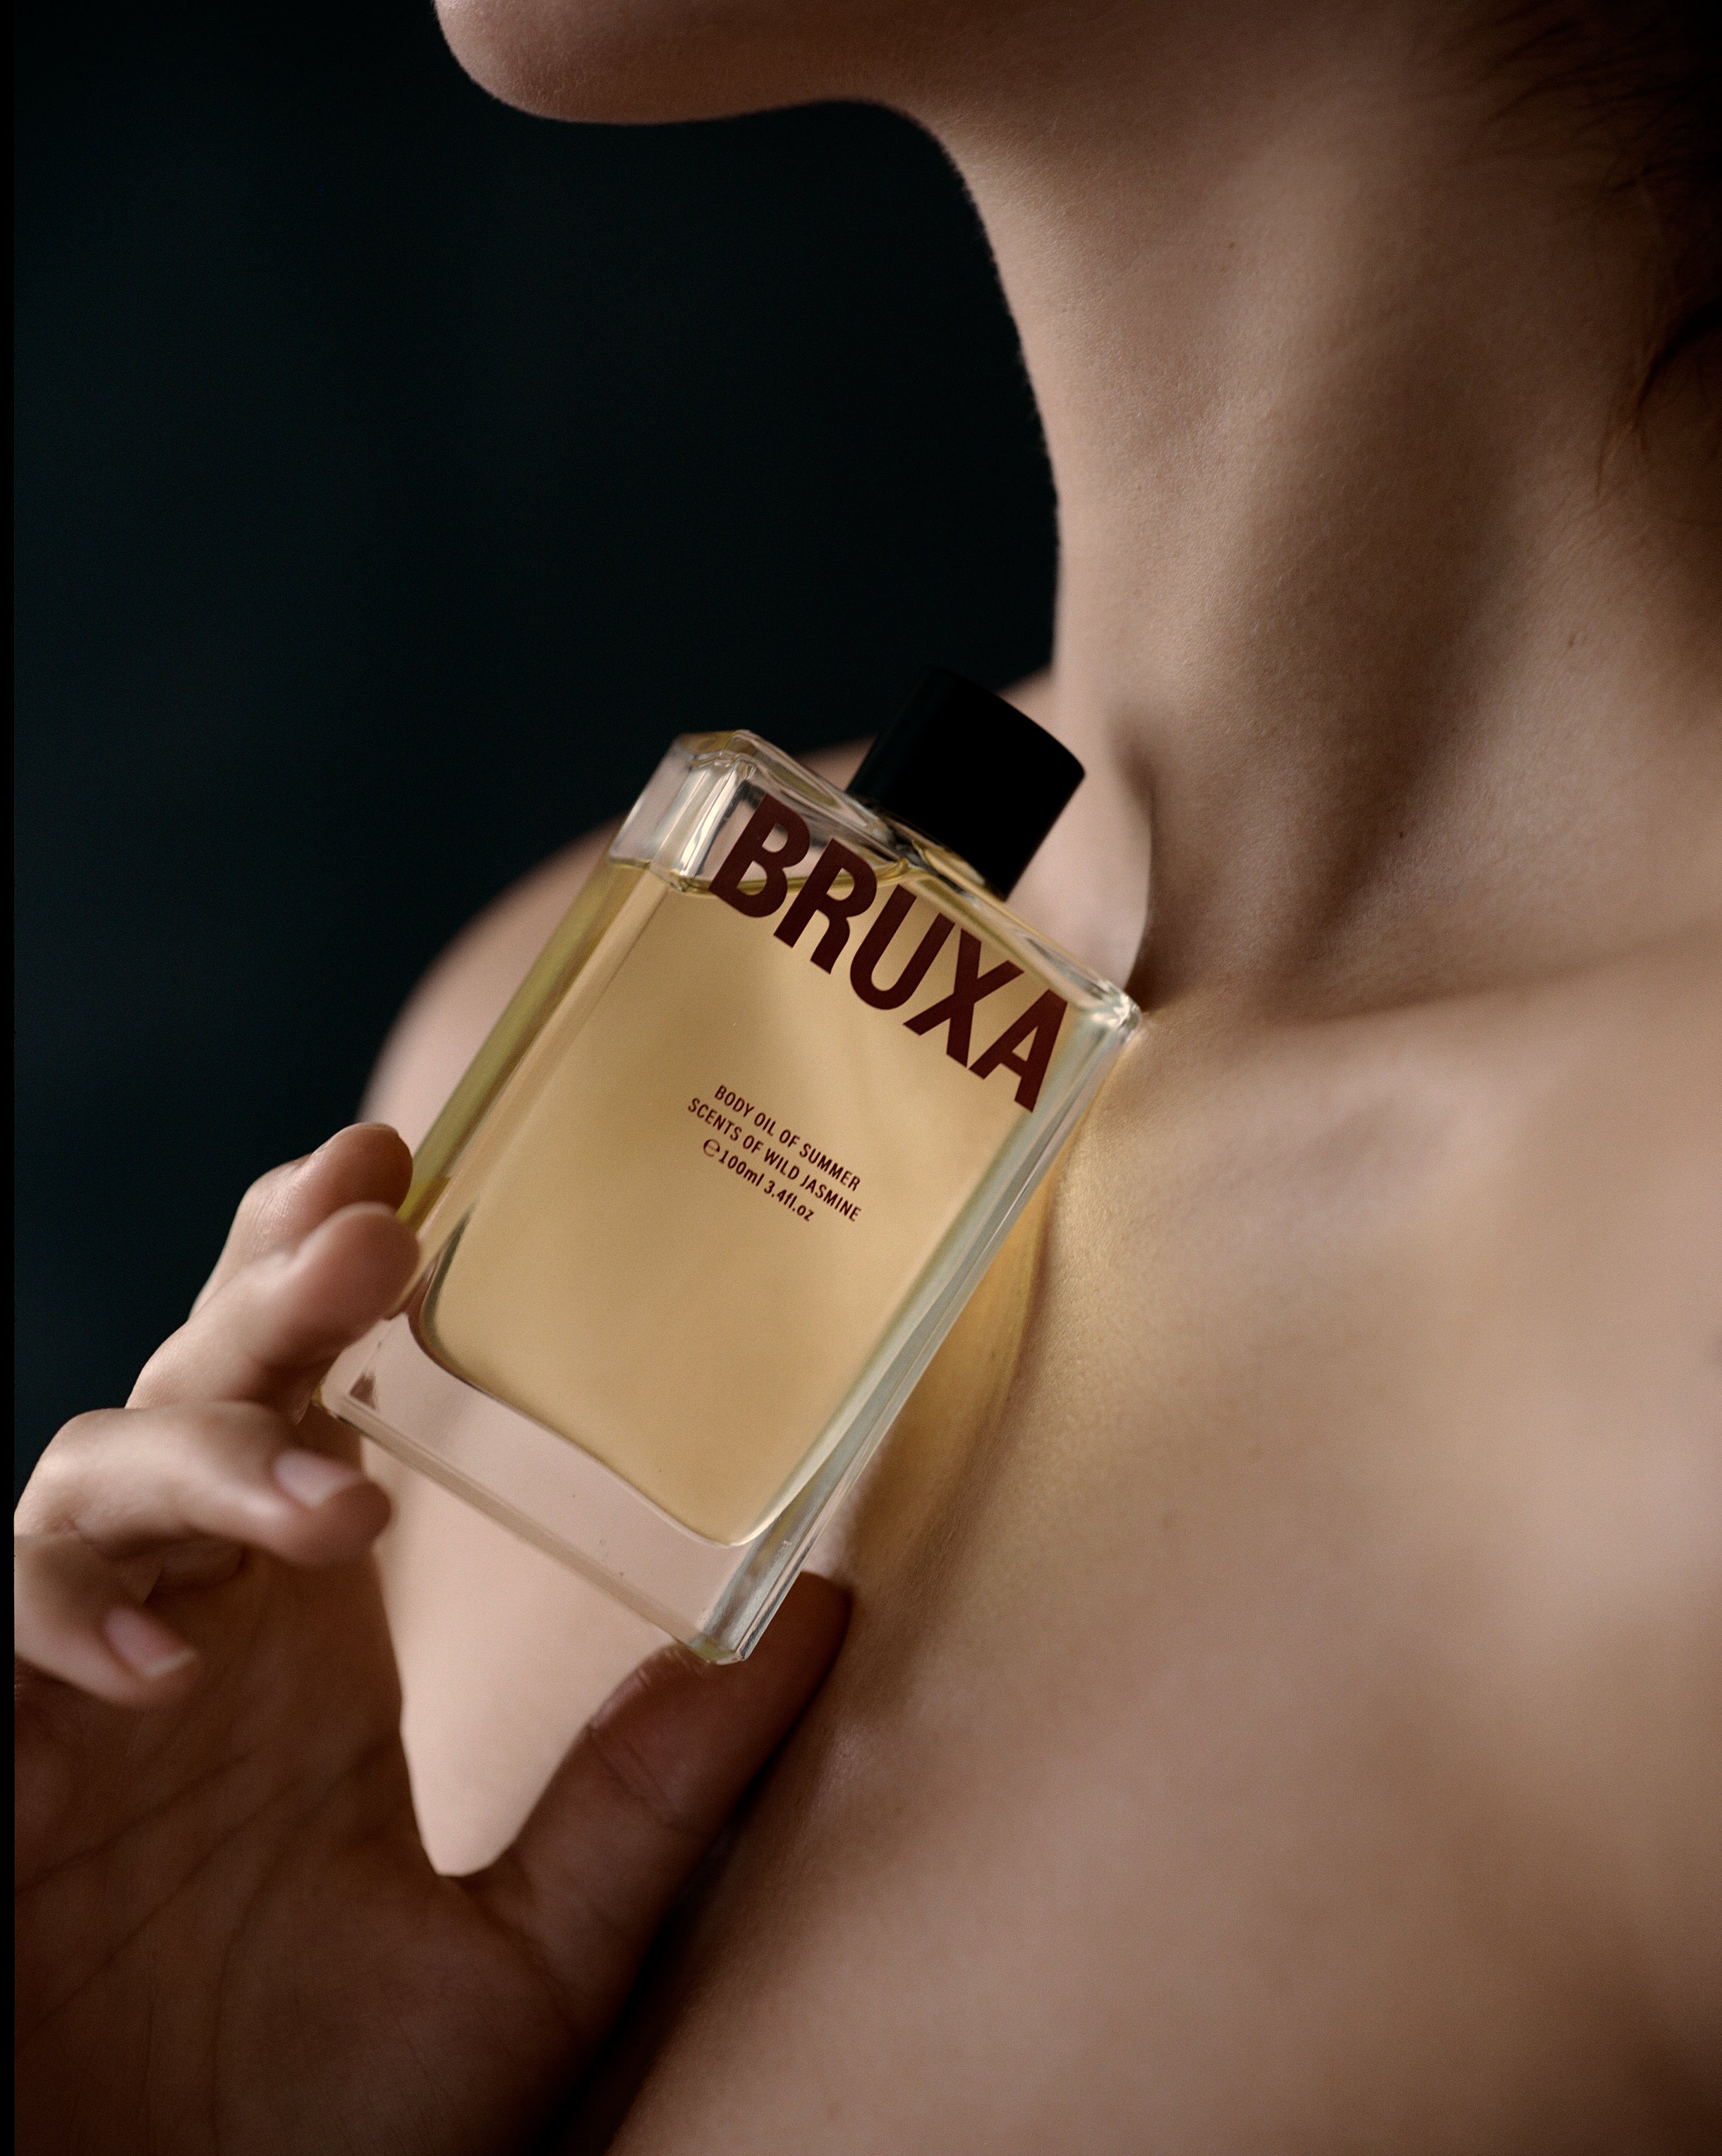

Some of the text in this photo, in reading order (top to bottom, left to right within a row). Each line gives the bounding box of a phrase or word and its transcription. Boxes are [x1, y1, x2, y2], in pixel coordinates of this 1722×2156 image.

[708, 793, 1068, 1113] BRUXA
[688, 1097, 861, 1222] SCENTS OF WILD JASMINE
[714, 1084, 861, 1191] BODY OIL OF SUMMER
[764, 1180, 814, 1222] 3.4fl.oz
